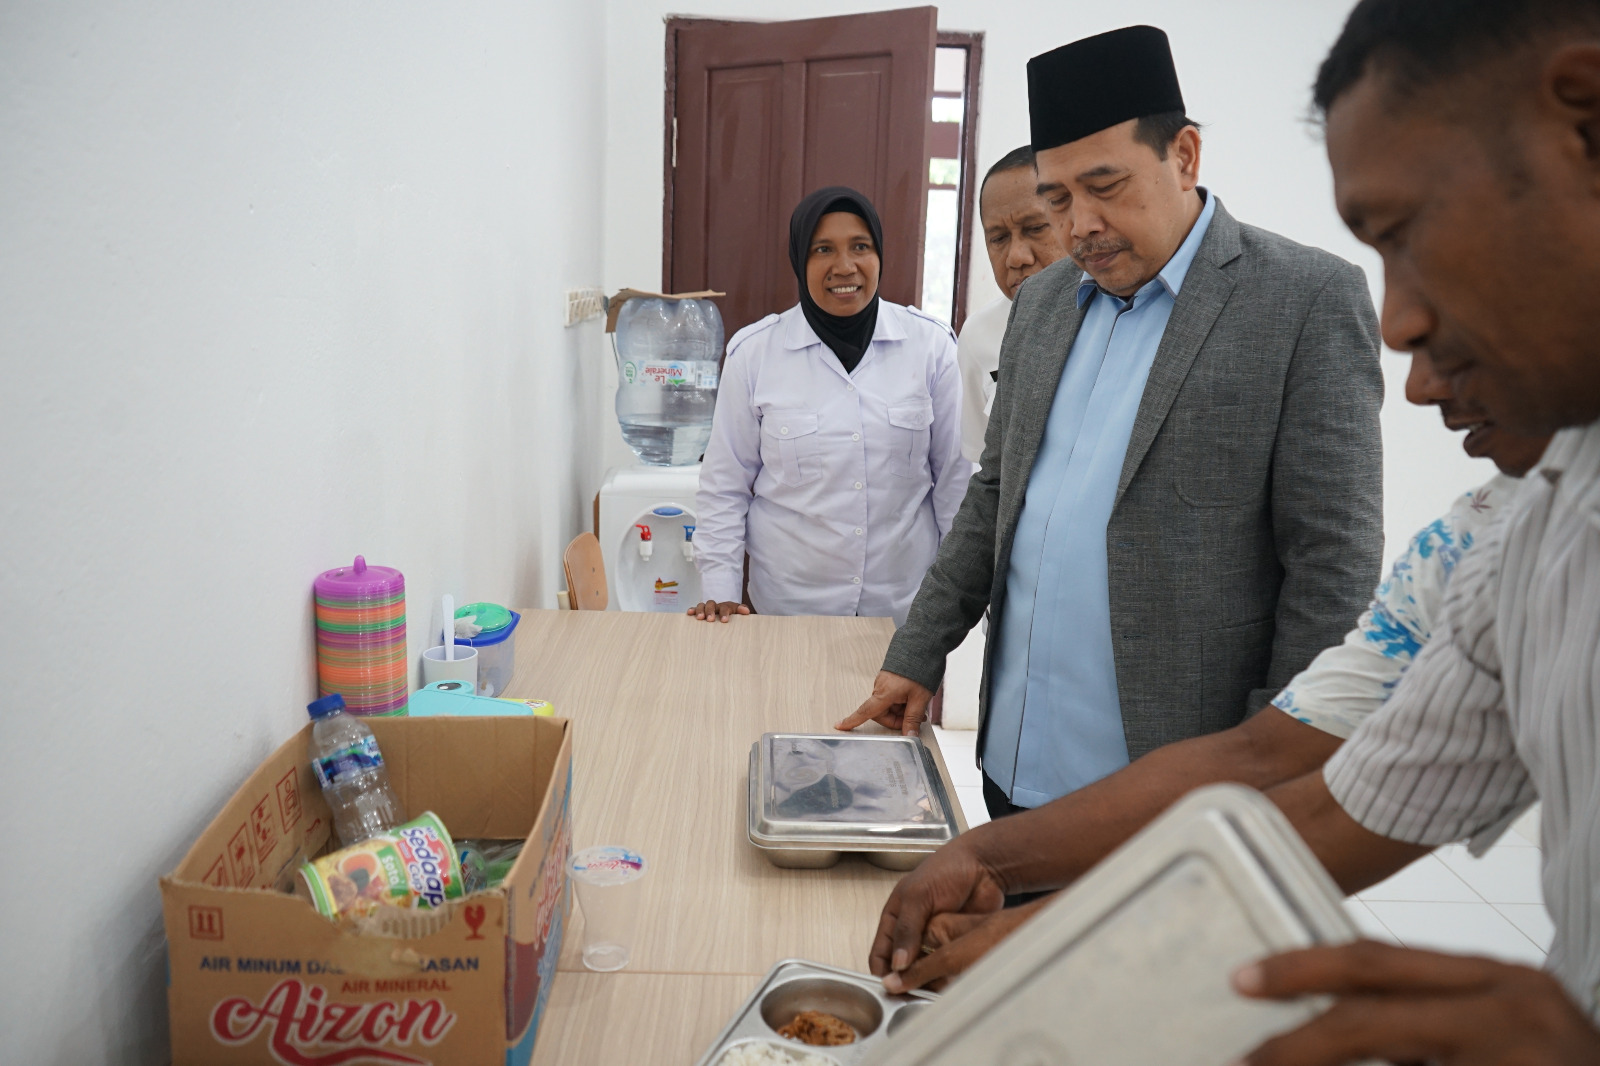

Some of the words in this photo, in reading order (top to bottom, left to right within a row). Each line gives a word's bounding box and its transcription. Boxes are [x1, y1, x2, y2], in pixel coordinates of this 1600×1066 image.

[645, 366, 683, 377] Minerale
[654, 375, 665, 384] Le
[402, 828, 443, 906] Sedaap
[409, 863, 422, 891] Cup
[199, 956, 231, 973] AIR
[237, 957, 302, 975] MINUM
[341, 980, 371, 994] AIR
[374, 979, 452, 993] MINERAL
[211, 978, 455, 1062] Aizon
